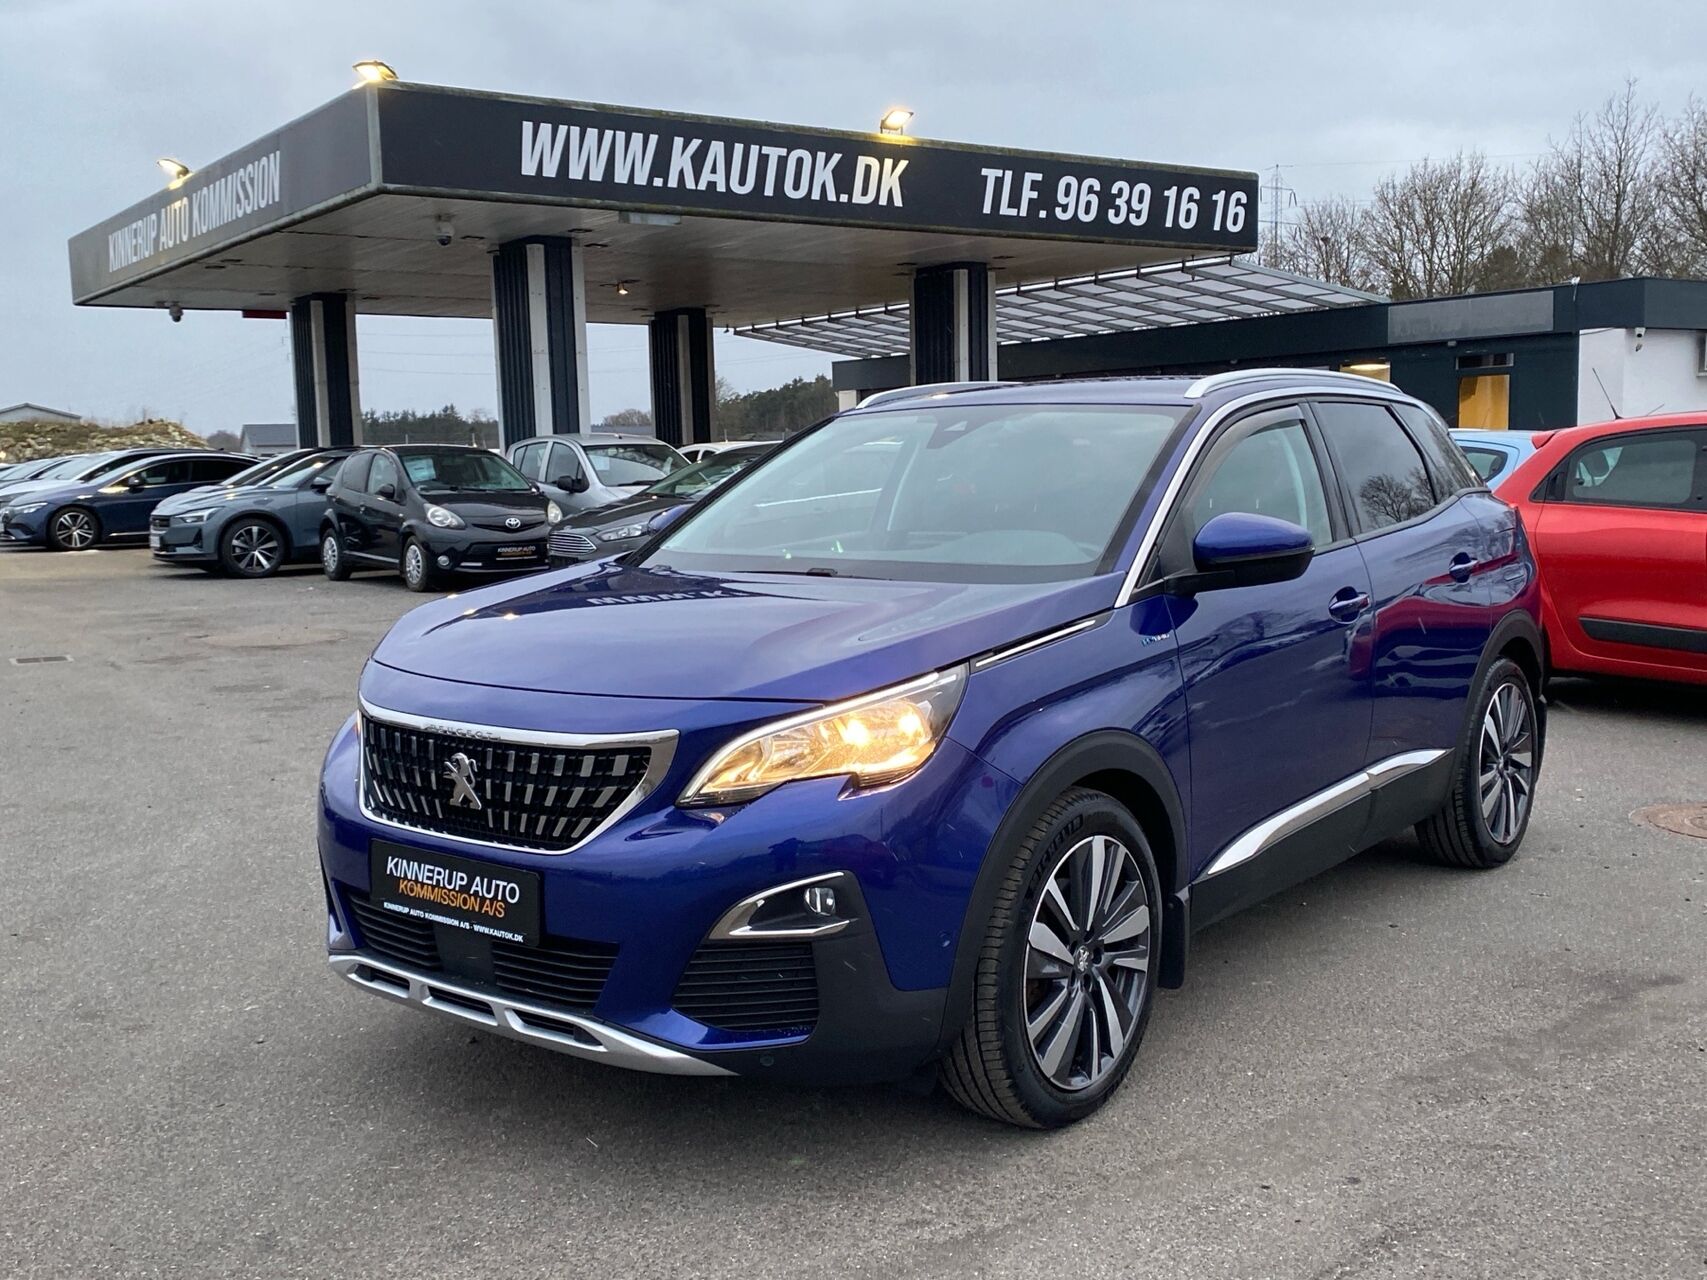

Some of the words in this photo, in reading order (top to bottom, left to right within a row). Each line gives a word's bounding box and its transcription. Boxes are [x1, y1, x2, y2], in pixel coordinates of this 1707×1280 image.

[521, 120, 909, 207] WWW.KAUTOK.DK
[108, 213, 158, 272] KINNERUP
[159, 196, 189, 251] AUTO
[192, 151, 280, 237] KOMMISSION
[981, 167, 1047, 219] TLF.
[1055, 175, 1101, 222] 96
[1107, 180, 1151, 226] 39
[1163, 186, 1200, 230] 16
[1212, 190, 1247, 233] 16
[386, 856, 467, 891] KINNERUP
[470, 876, 520, 904] AUTO
[399, 879, 480, 912] KOMMISSION
[481, 899, 505, 918] A/S
[383, 902, 409, 913] KINNERUP
[409, 908, 424, 918] AUTO
[424, 912, 459, 927] KOMMISSION
[473, 924, 524, 942] WWW.KAUTOK.DK
